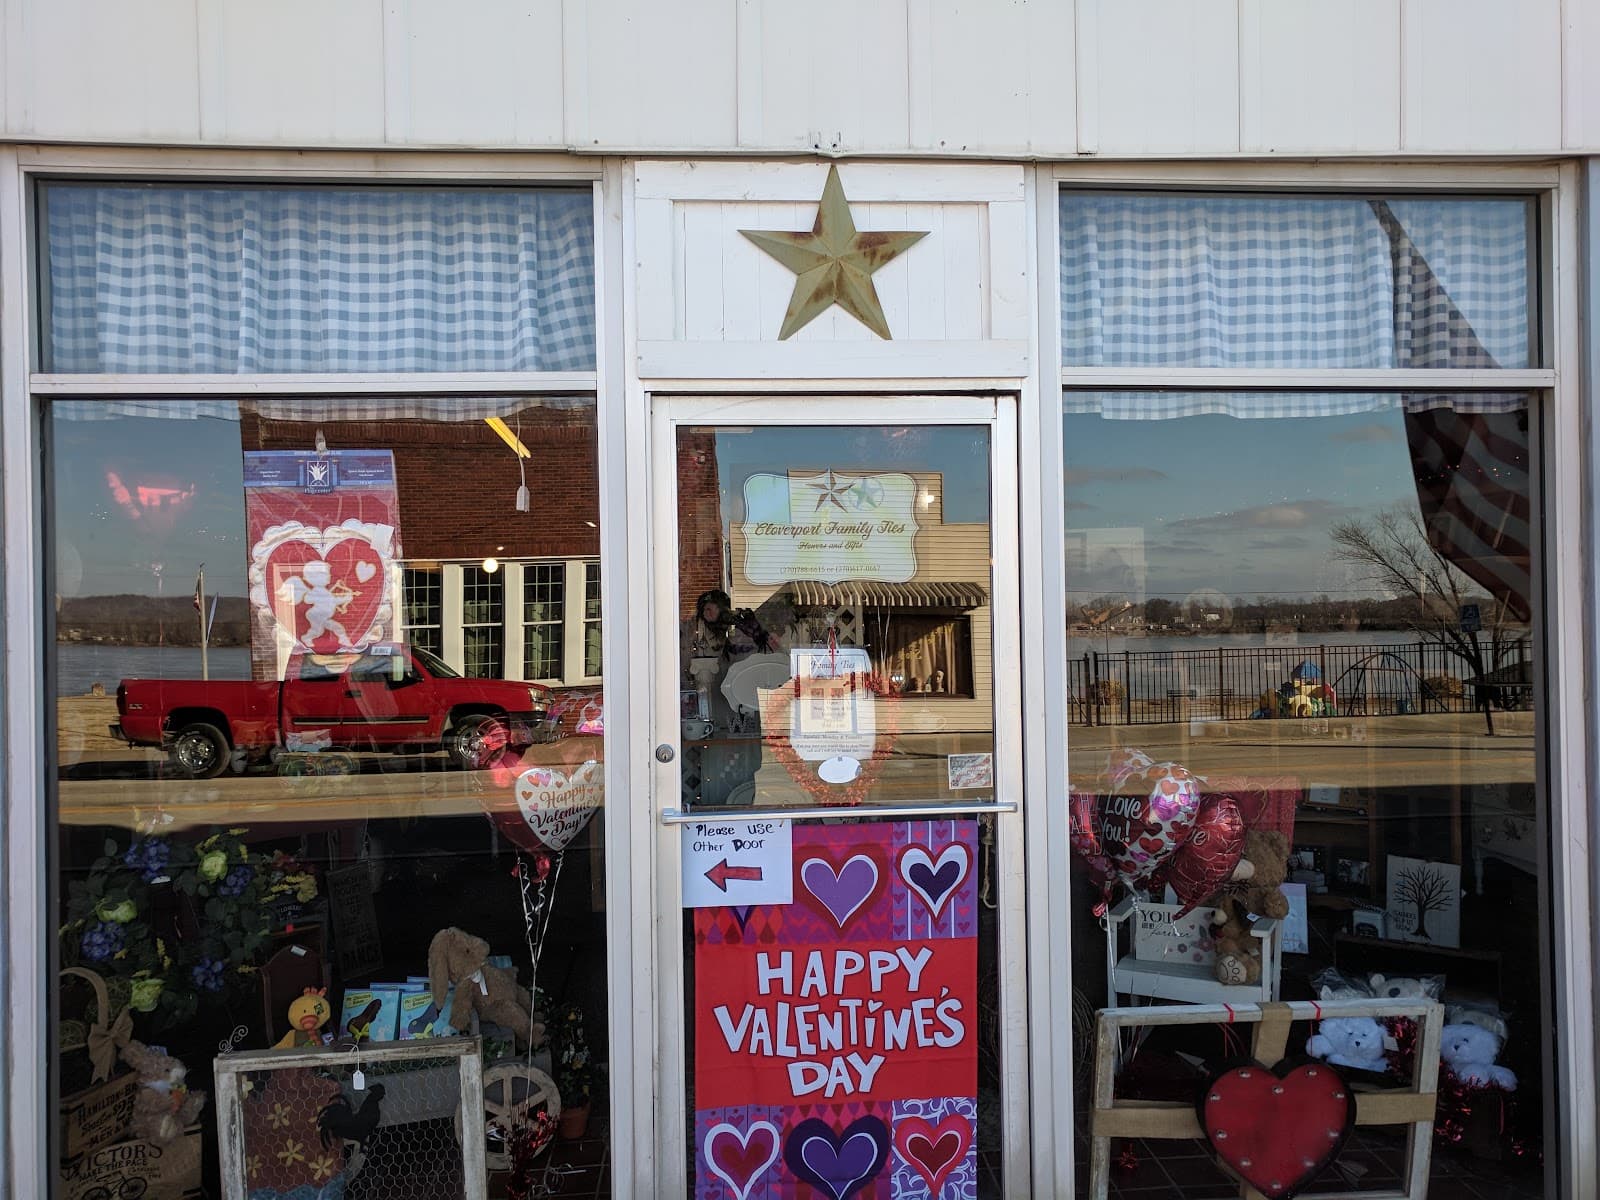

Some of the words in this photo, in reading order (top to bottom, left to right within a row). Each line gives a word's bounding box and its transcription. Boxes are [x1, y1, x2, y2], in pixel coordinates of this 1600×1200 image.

[754, 520, 821, 538] Cloverport
[824, 520, 874, 541] Family
[876, 519, 907, 535] Ties
[539, 784, 586, 809] Happy
[1104, 790, 1143, 820] Love
[550, 814, 583, 837] Day!
[696, 823, 735, 837] Please
[1099, 816, 1131, 842] You!
[693, 840, 724, 852] Other
[732, 838, 766, 852] Door
[756, 946, 933, 998] HAPPY
[787, 1052, 886, 1098] DAY
[104, 1161, 123, 1172] THE
[125, 1157, 148, 1168] PACE
